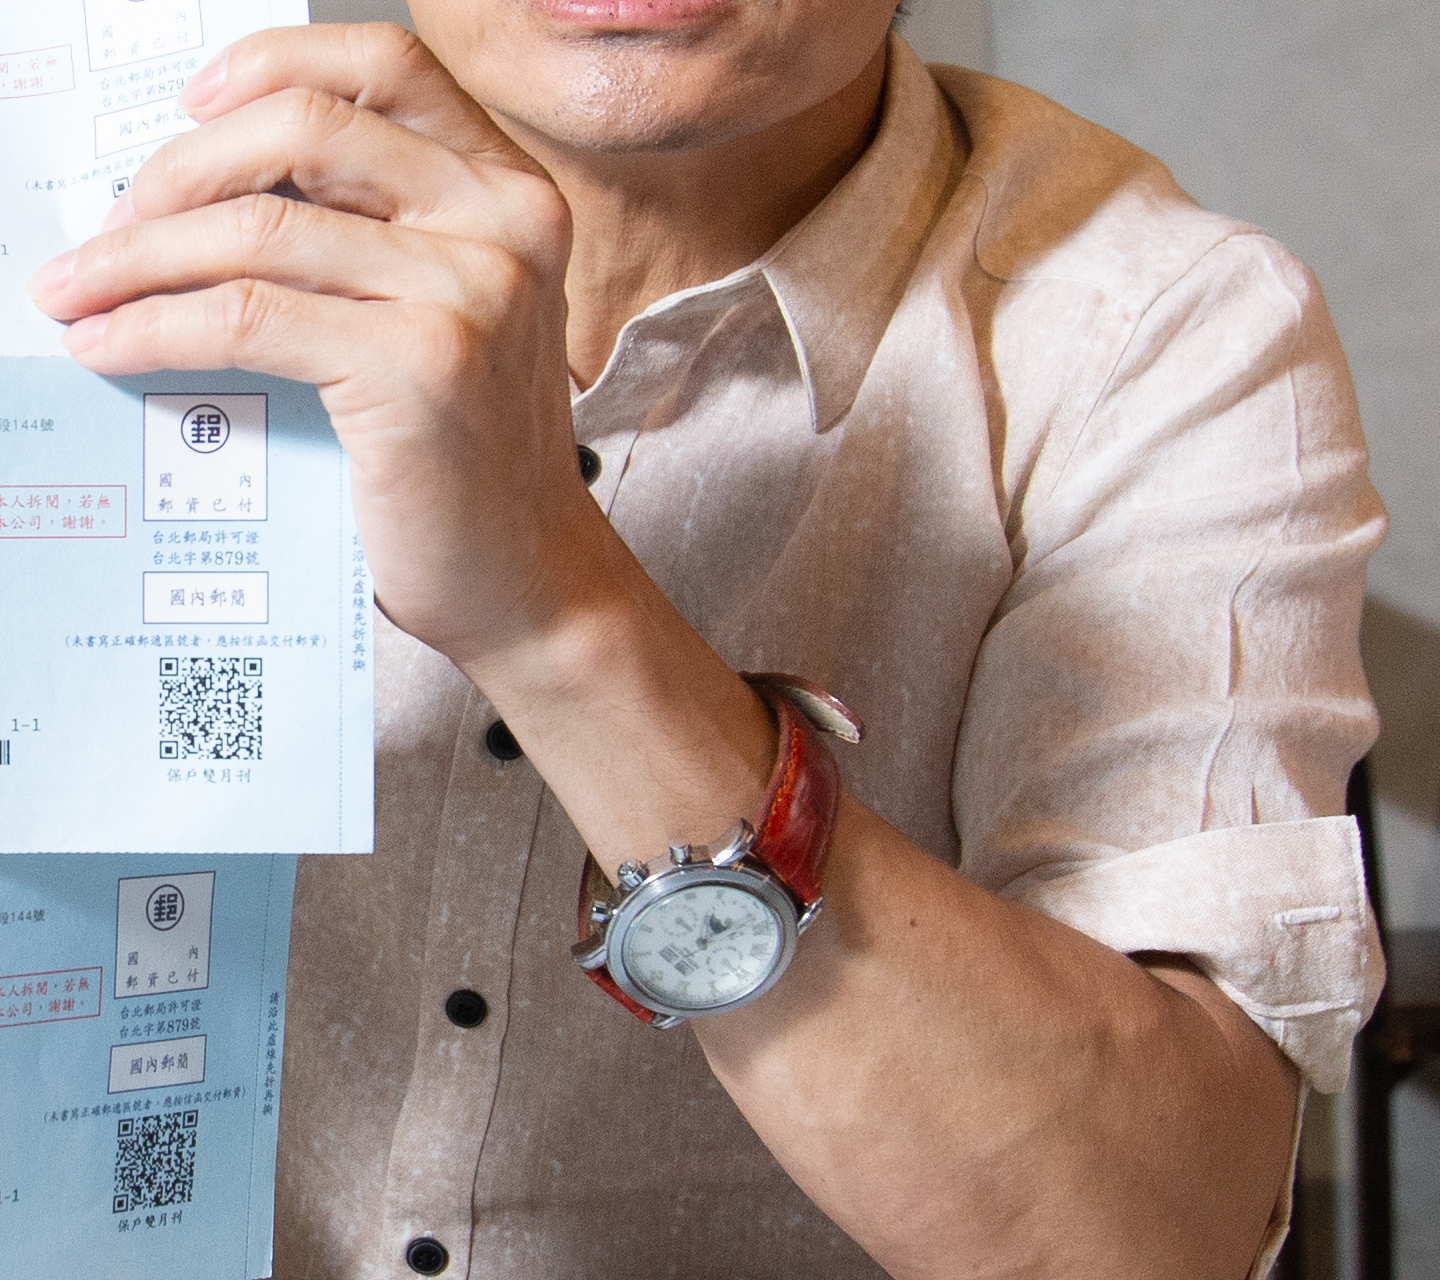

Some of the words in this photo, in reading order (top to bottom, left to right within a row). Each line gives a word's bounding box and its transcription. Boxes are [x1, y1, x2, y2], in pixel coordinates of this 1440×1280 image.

[158, 496, 254, 514] 郵資已付
[152, 529, 261, 545] 台北郵局許可證
[152, 549, 261, 567] 台北字第879號
[169, 587, 247, 607] 國內郵簡
[10, 717, 41, 733] 1-1
[166, 768, 254, 786] 保戶雙月刊
[125, 968, 200, 989] 郵資已付
[118, 1016, 201, 1039] 台北字第879號
[129, 1052, 190, 1076] 國內郵簡
[117, 1210, 184, 1234] 保戶雙月刊
